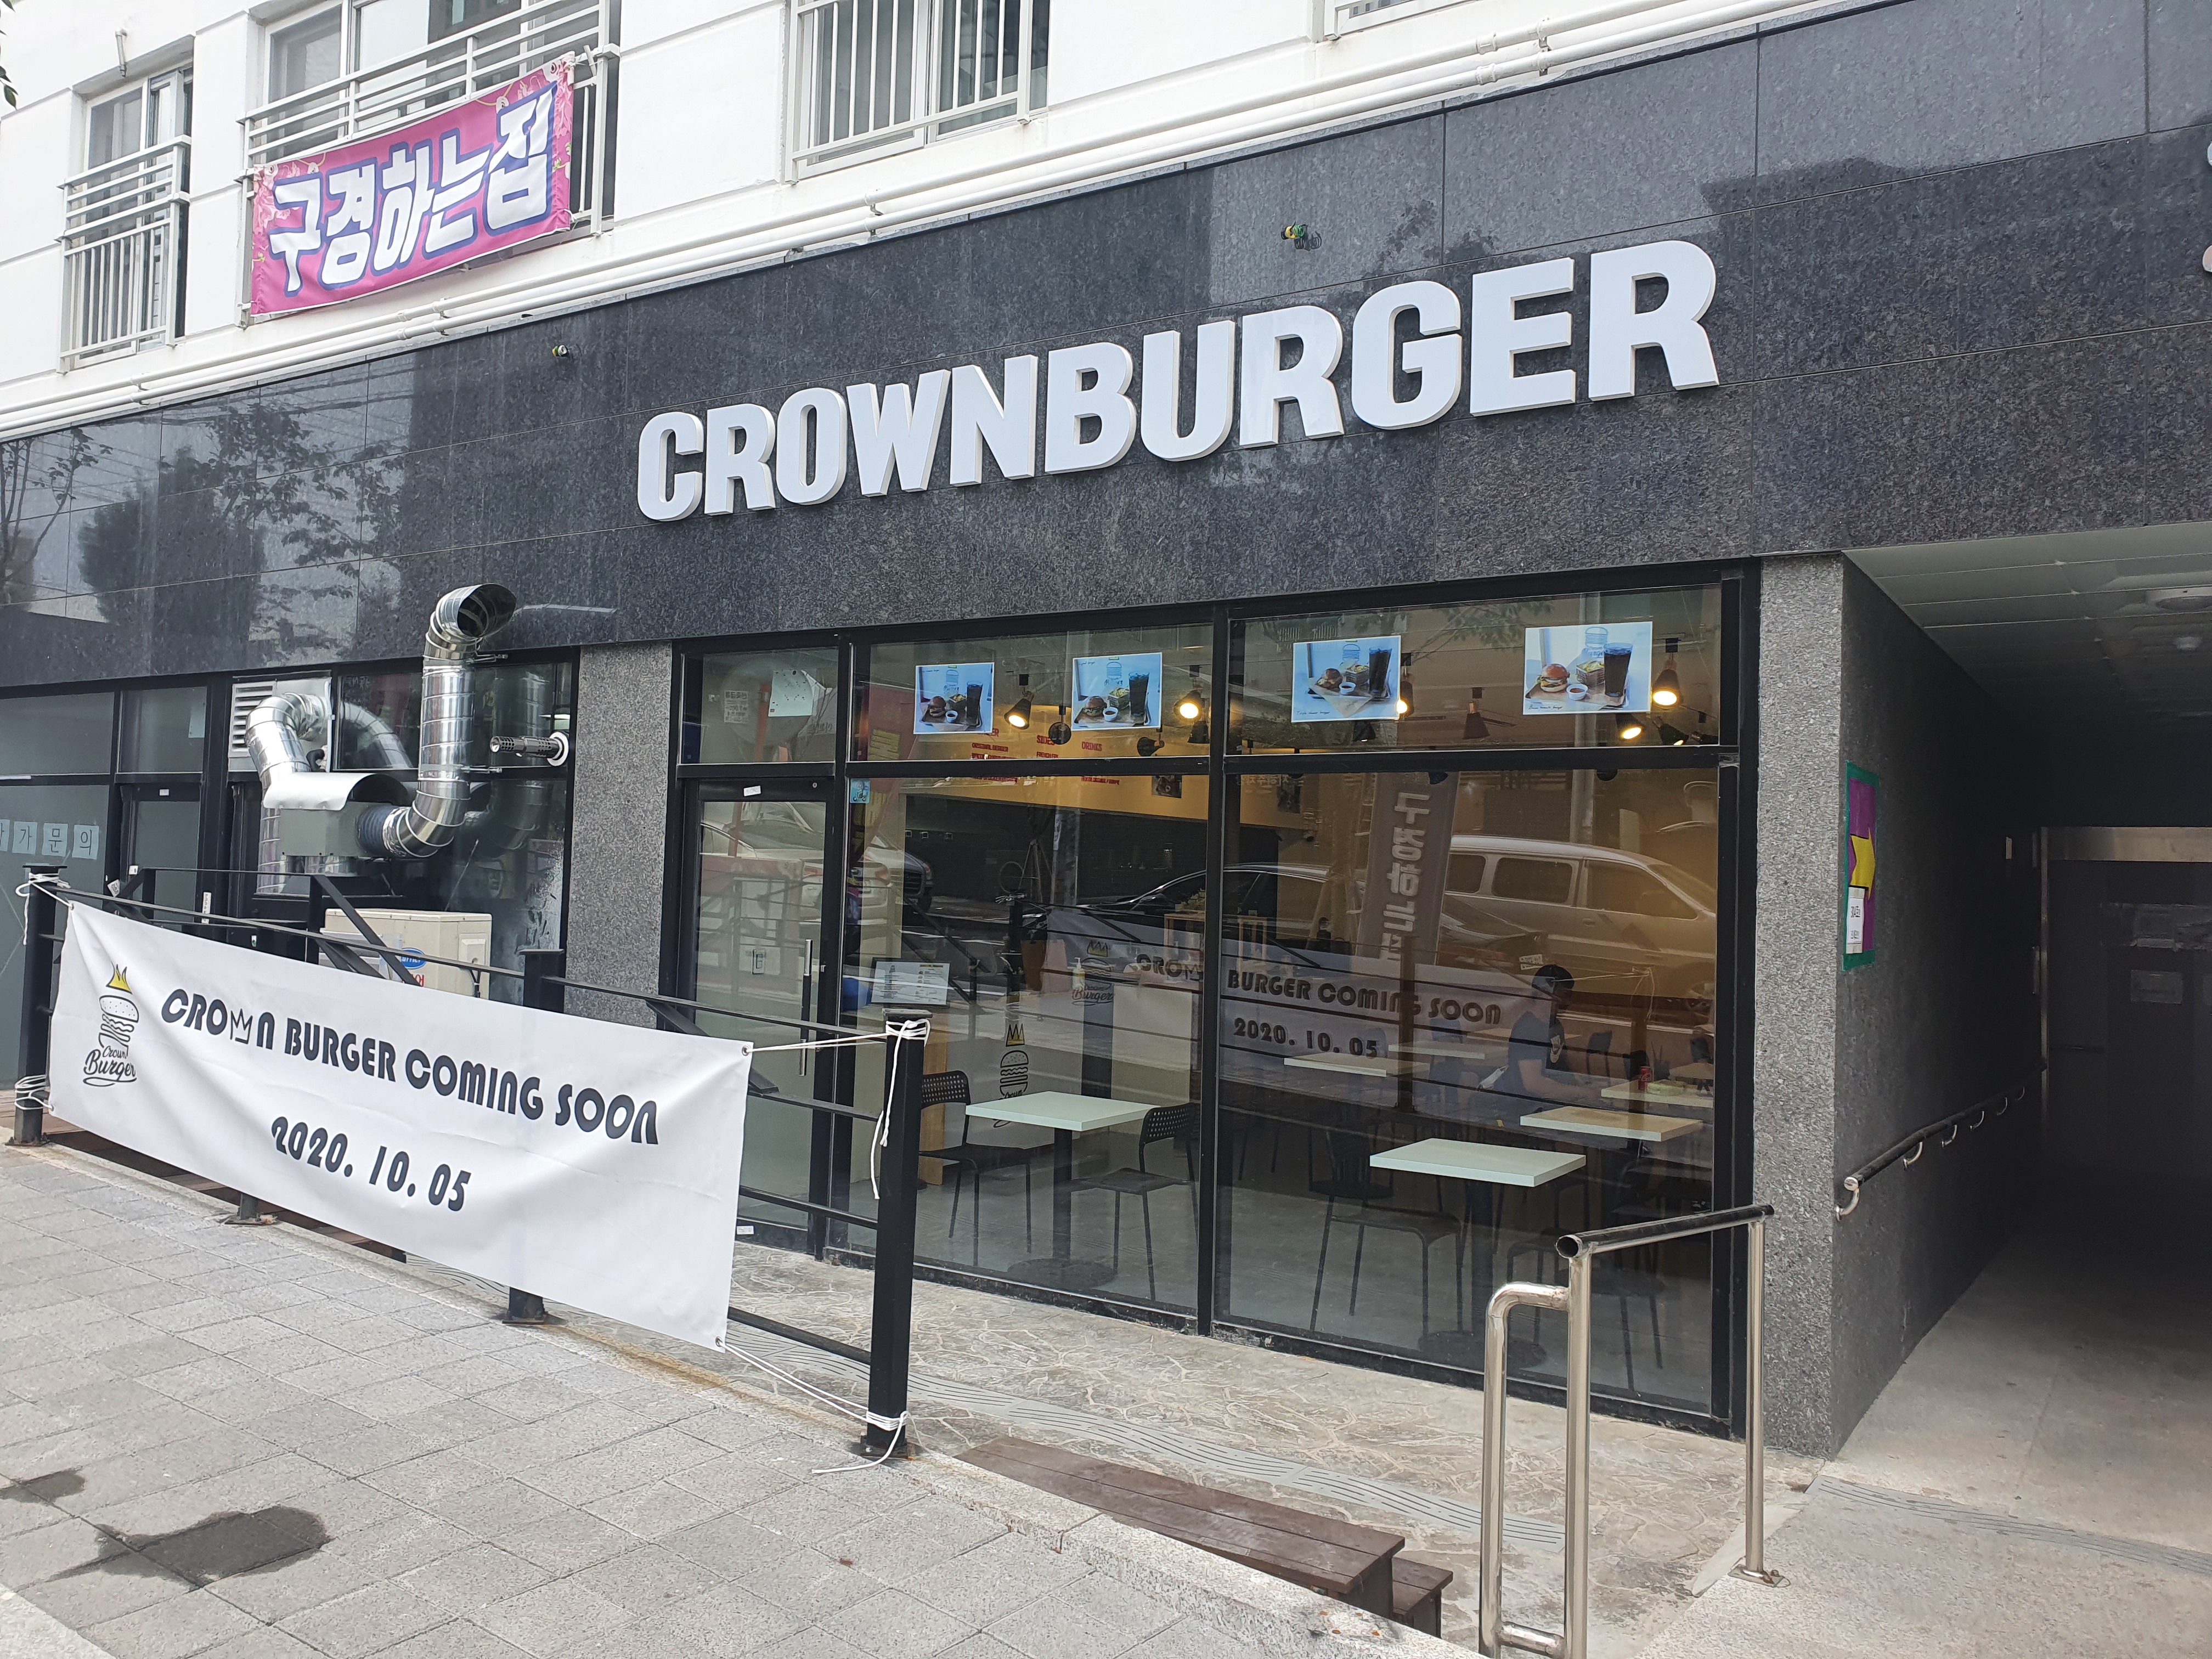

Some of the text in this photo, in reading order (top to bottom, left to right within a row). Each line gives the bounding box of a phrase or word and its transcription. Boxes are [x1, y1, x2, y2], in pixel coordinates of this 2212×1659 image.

[637, 240, 1720, 522] CROWNBURGER
[83, 1048, 137, 1084] Burger
[285, 1017, 396, 1082] BURGER
[405, 1048, 544, 1121] COMING
[555, 1084, 659, 1145] SOON
[272, 1116, 472, 1211] 2020. 10. 05
